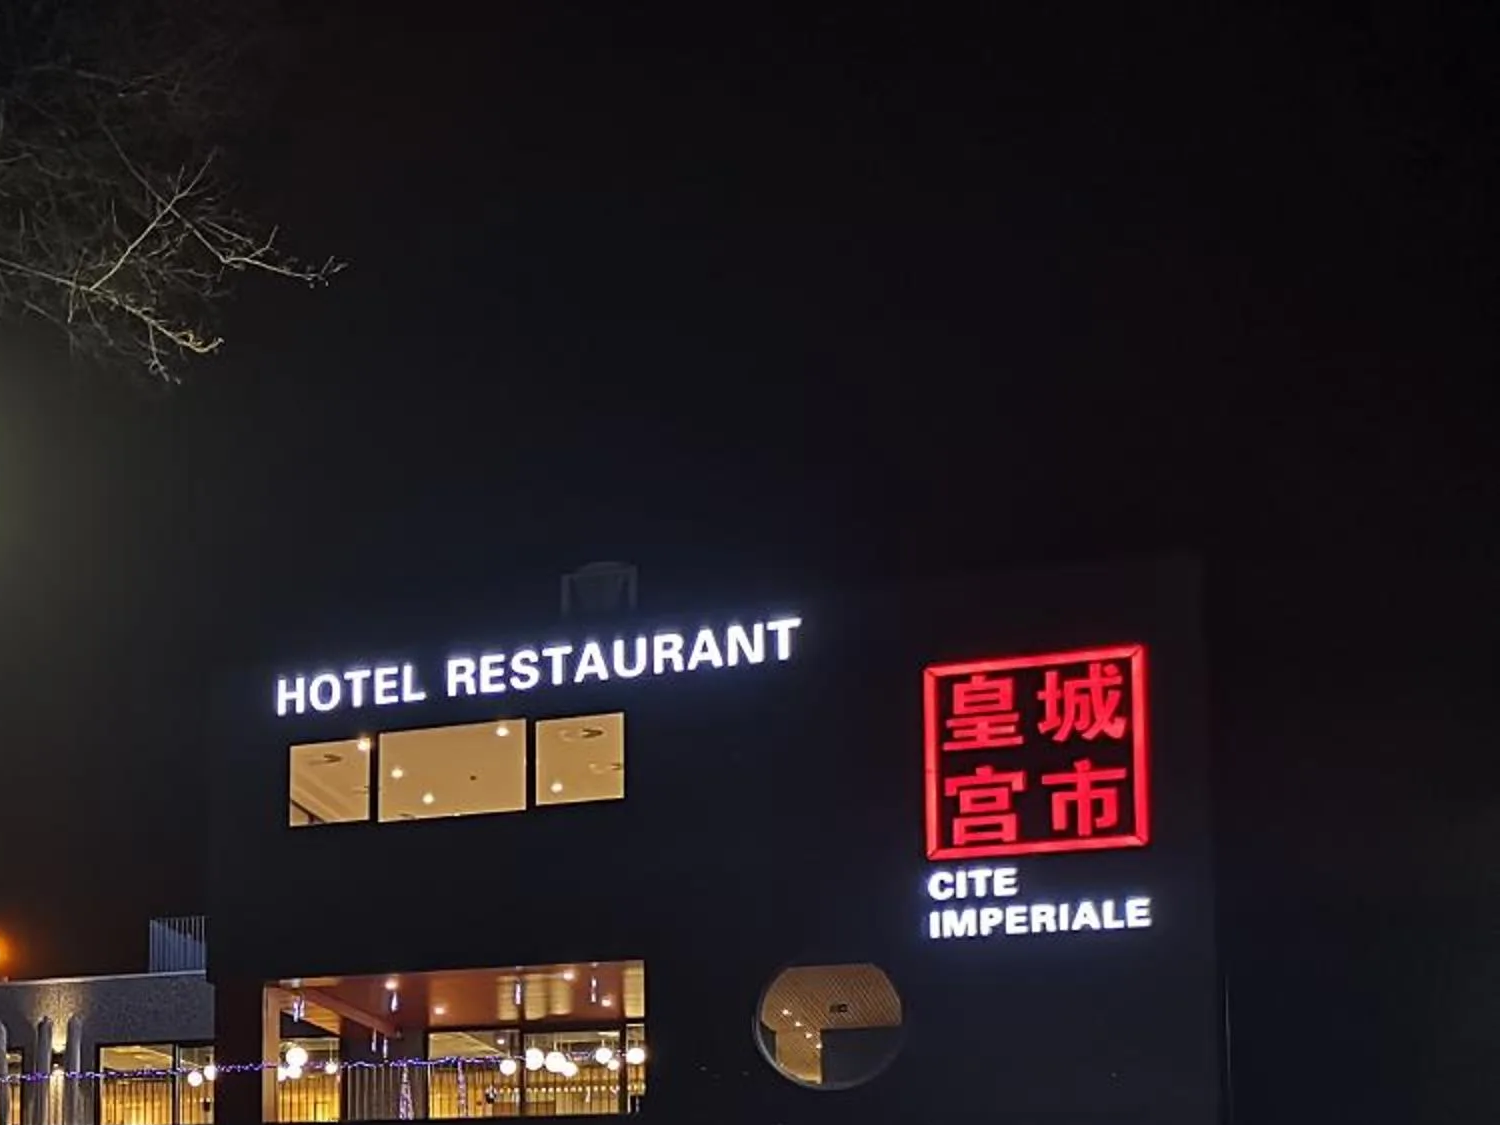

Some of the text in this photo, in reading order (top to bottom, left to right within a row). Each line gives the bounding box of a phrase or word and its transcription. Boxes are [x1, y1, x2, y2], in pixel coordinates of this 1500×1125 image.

[277, 617, 802, 716] HOTEL RESTAURANT
[927, 867, 1019, 901] CITE
[928, 897, 1152, 939] IMPERIALE
